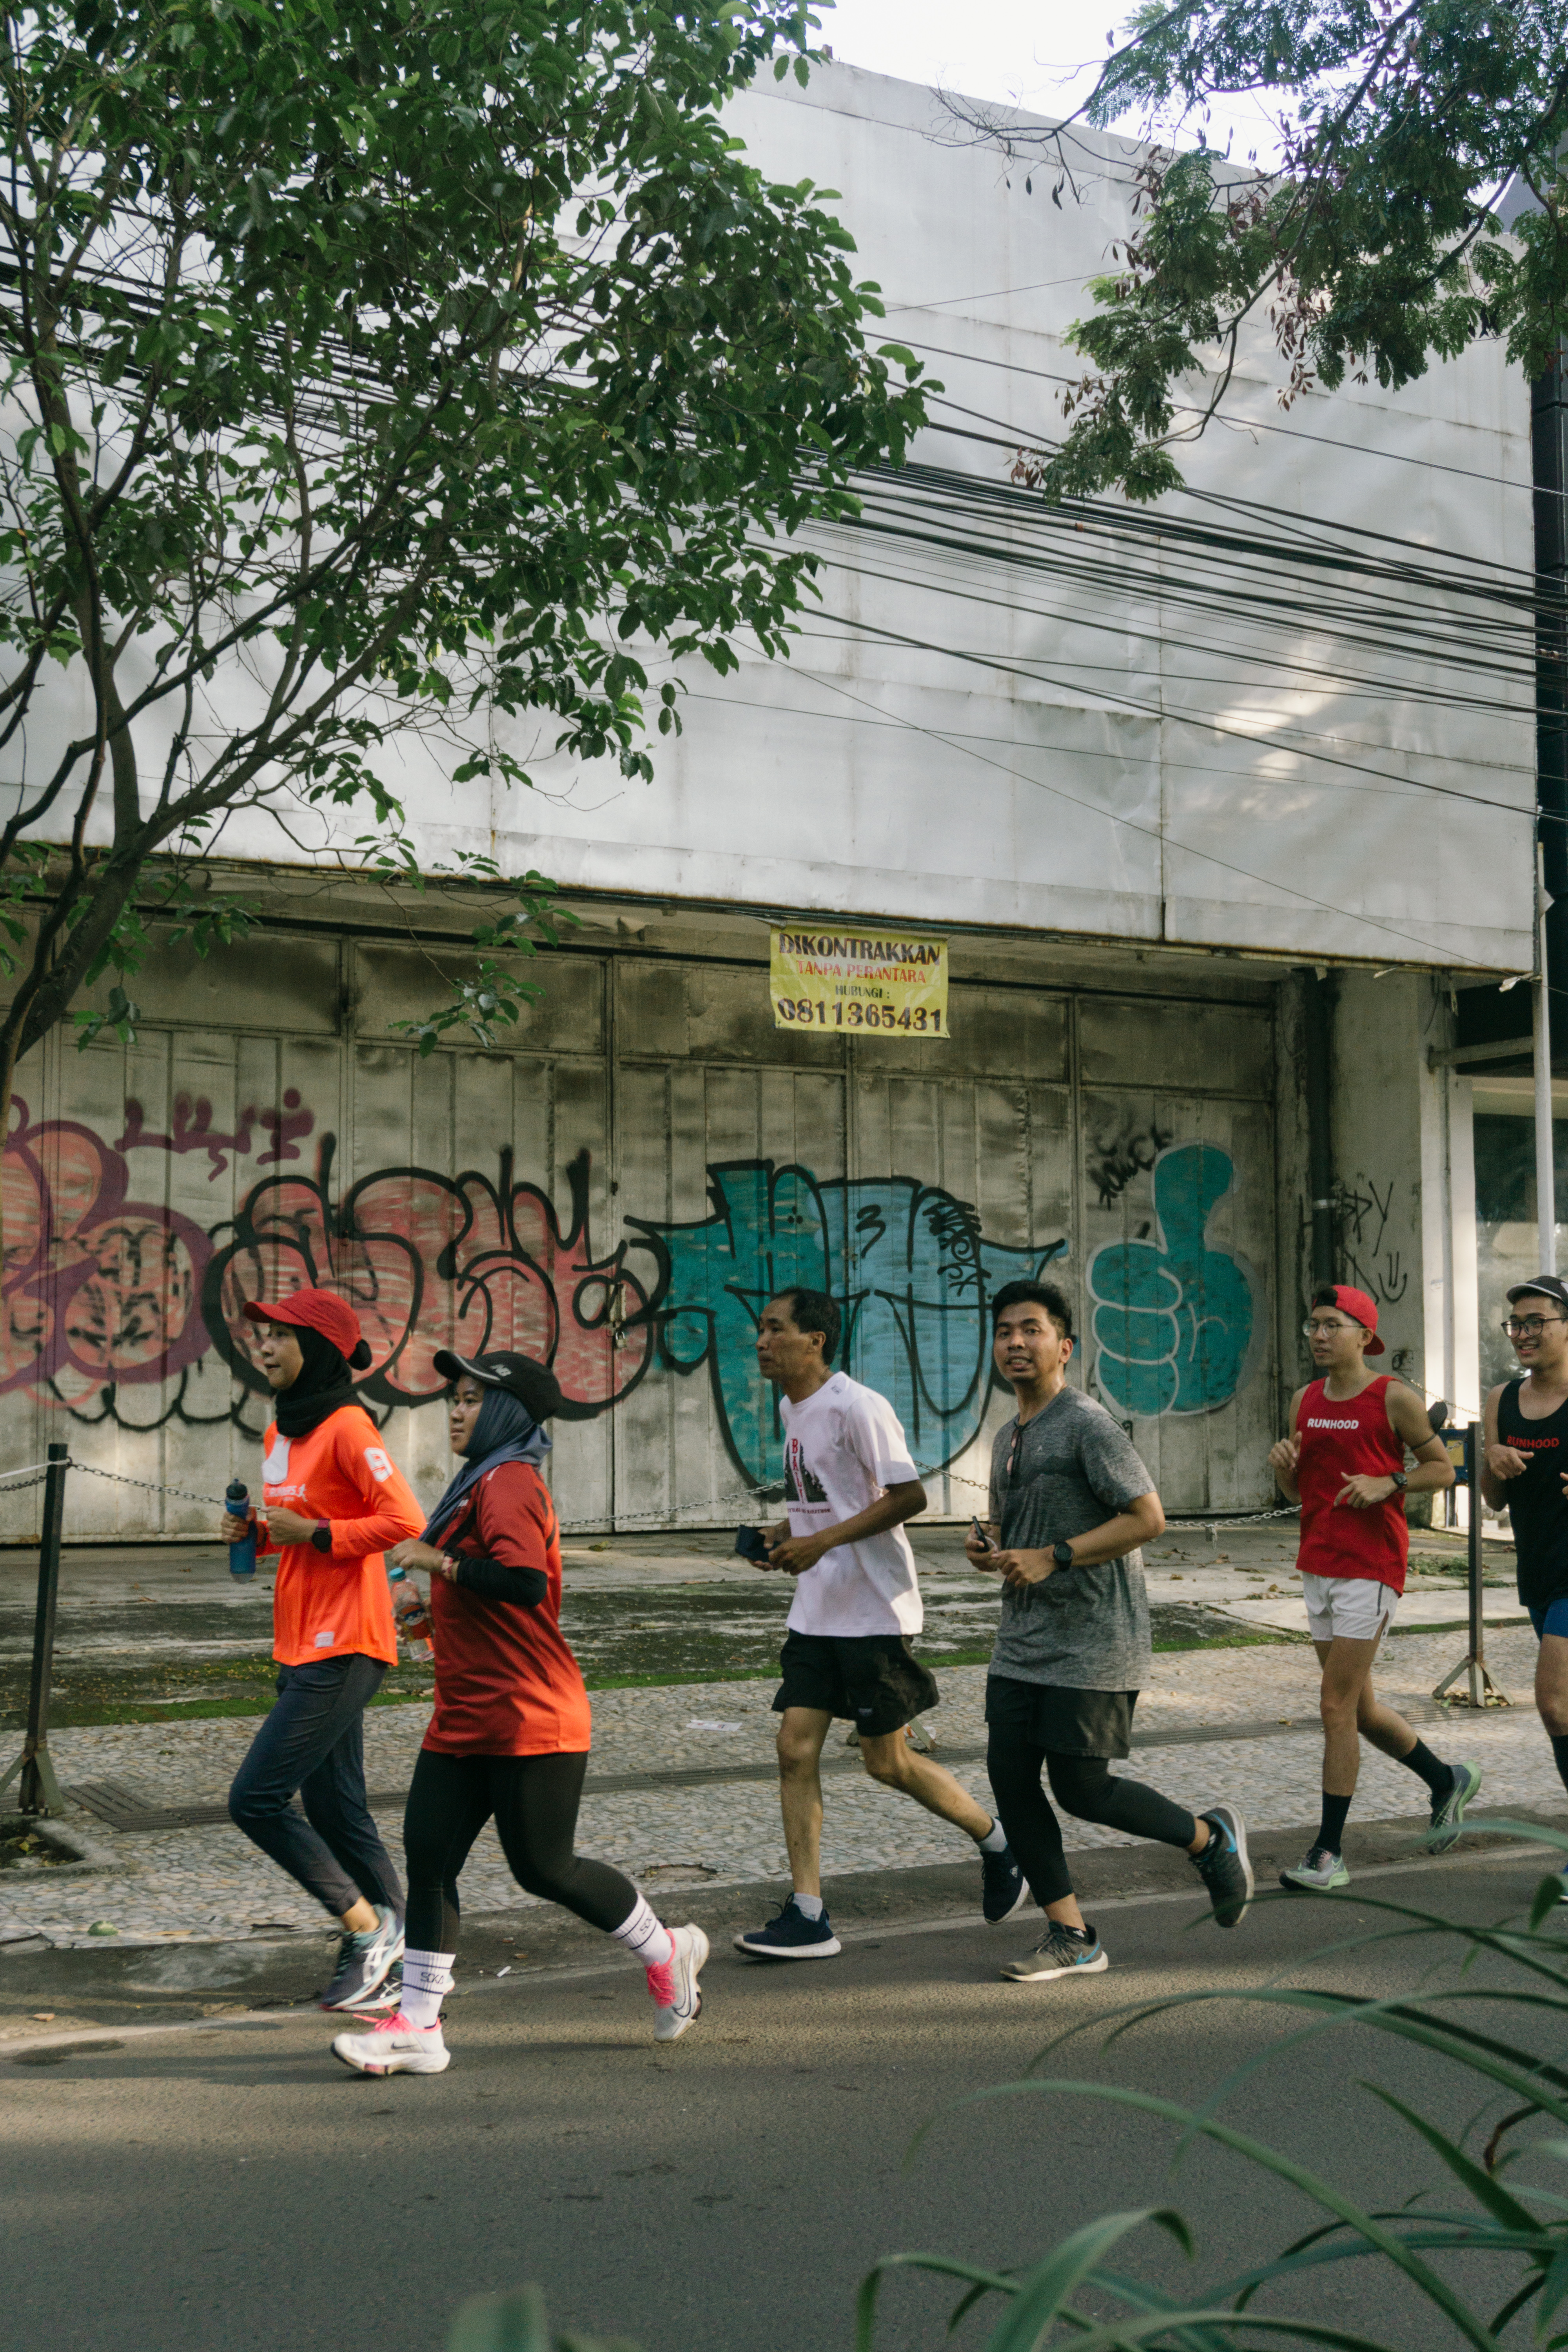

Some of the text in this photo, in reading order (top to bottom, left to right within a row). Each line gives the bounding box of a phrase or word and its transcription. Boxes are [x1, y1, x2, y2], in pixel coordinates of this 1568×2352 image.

[779, 933, 940, 965] DIKONTRAKKAN
[797, 960, 926, 984] TANPA PERANTARA
[835, 985, 882, 998] HUBUNGI
[777, 998, 941, 1032] 0811365431
[1307, 1418, 1359, 1429] RUNHOOD
[1506, 1435, 1559, 1448] RUNHOOD
